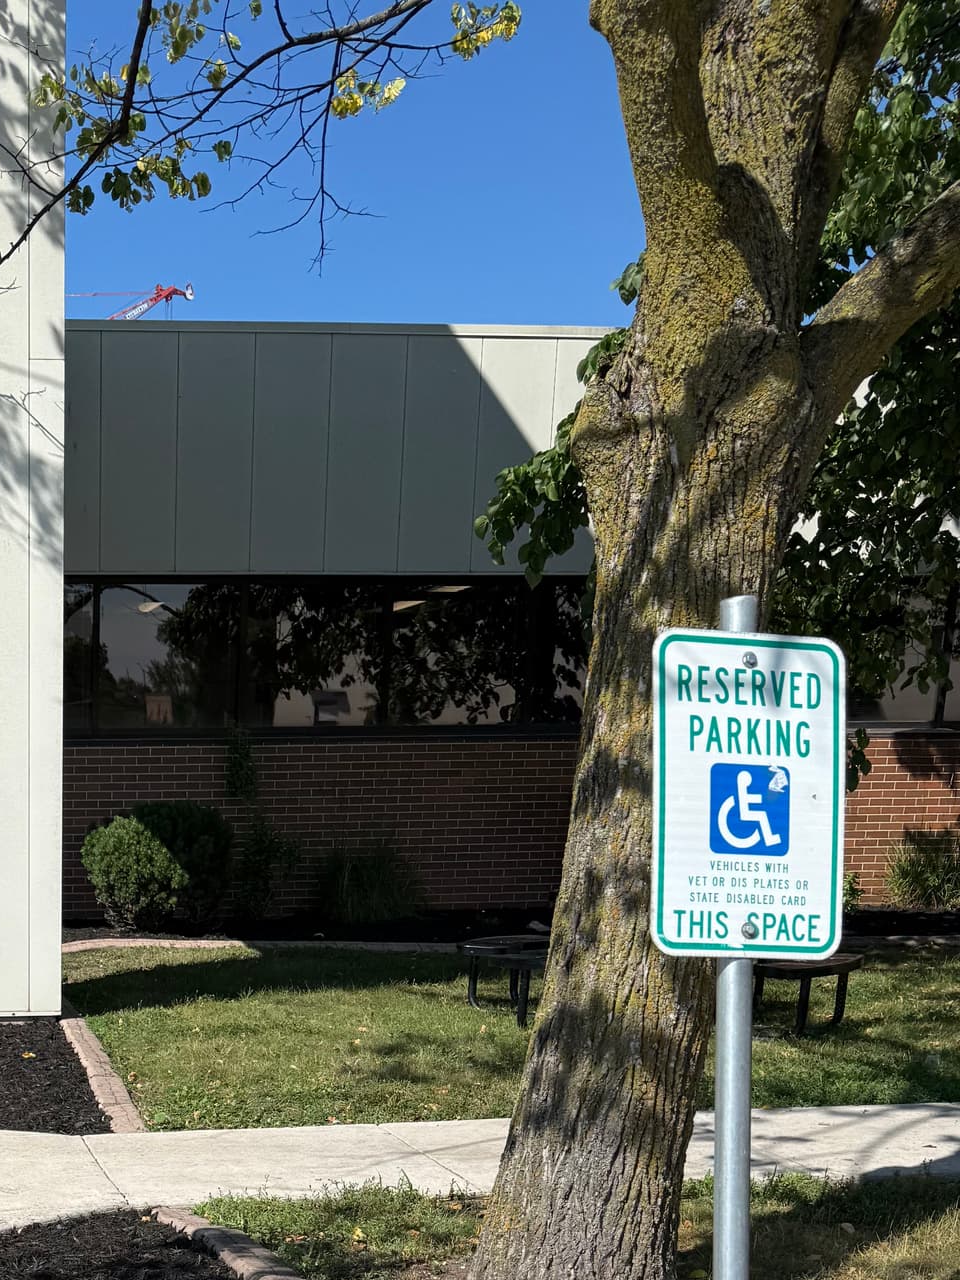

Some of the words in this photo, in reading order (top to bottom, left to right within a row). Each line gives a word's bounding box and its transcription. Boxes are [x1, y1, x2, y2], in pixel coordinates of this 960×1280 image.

[677, 663, 822, 710] RESERVED
[689, 714, 811, 758] PARKING
[709, 860, 760, 873] VEHICLES
[765, 863, 789, 874] WITH
[688, 875, 707, 886] VET
[712, 876, 725, 887] OR
[731, 877, 748, 888] DIS
[753, 878, 790, 890] PLATES
[795, 880, 809, 891] OR
[689, 891, 720, 903] STATE
[726, 892, 775, 905] DISABLED
[781, 895, 807, 906] CARD
[673, 909, 729, 939] THIS
[744, 911, 821, 942] SPACE
